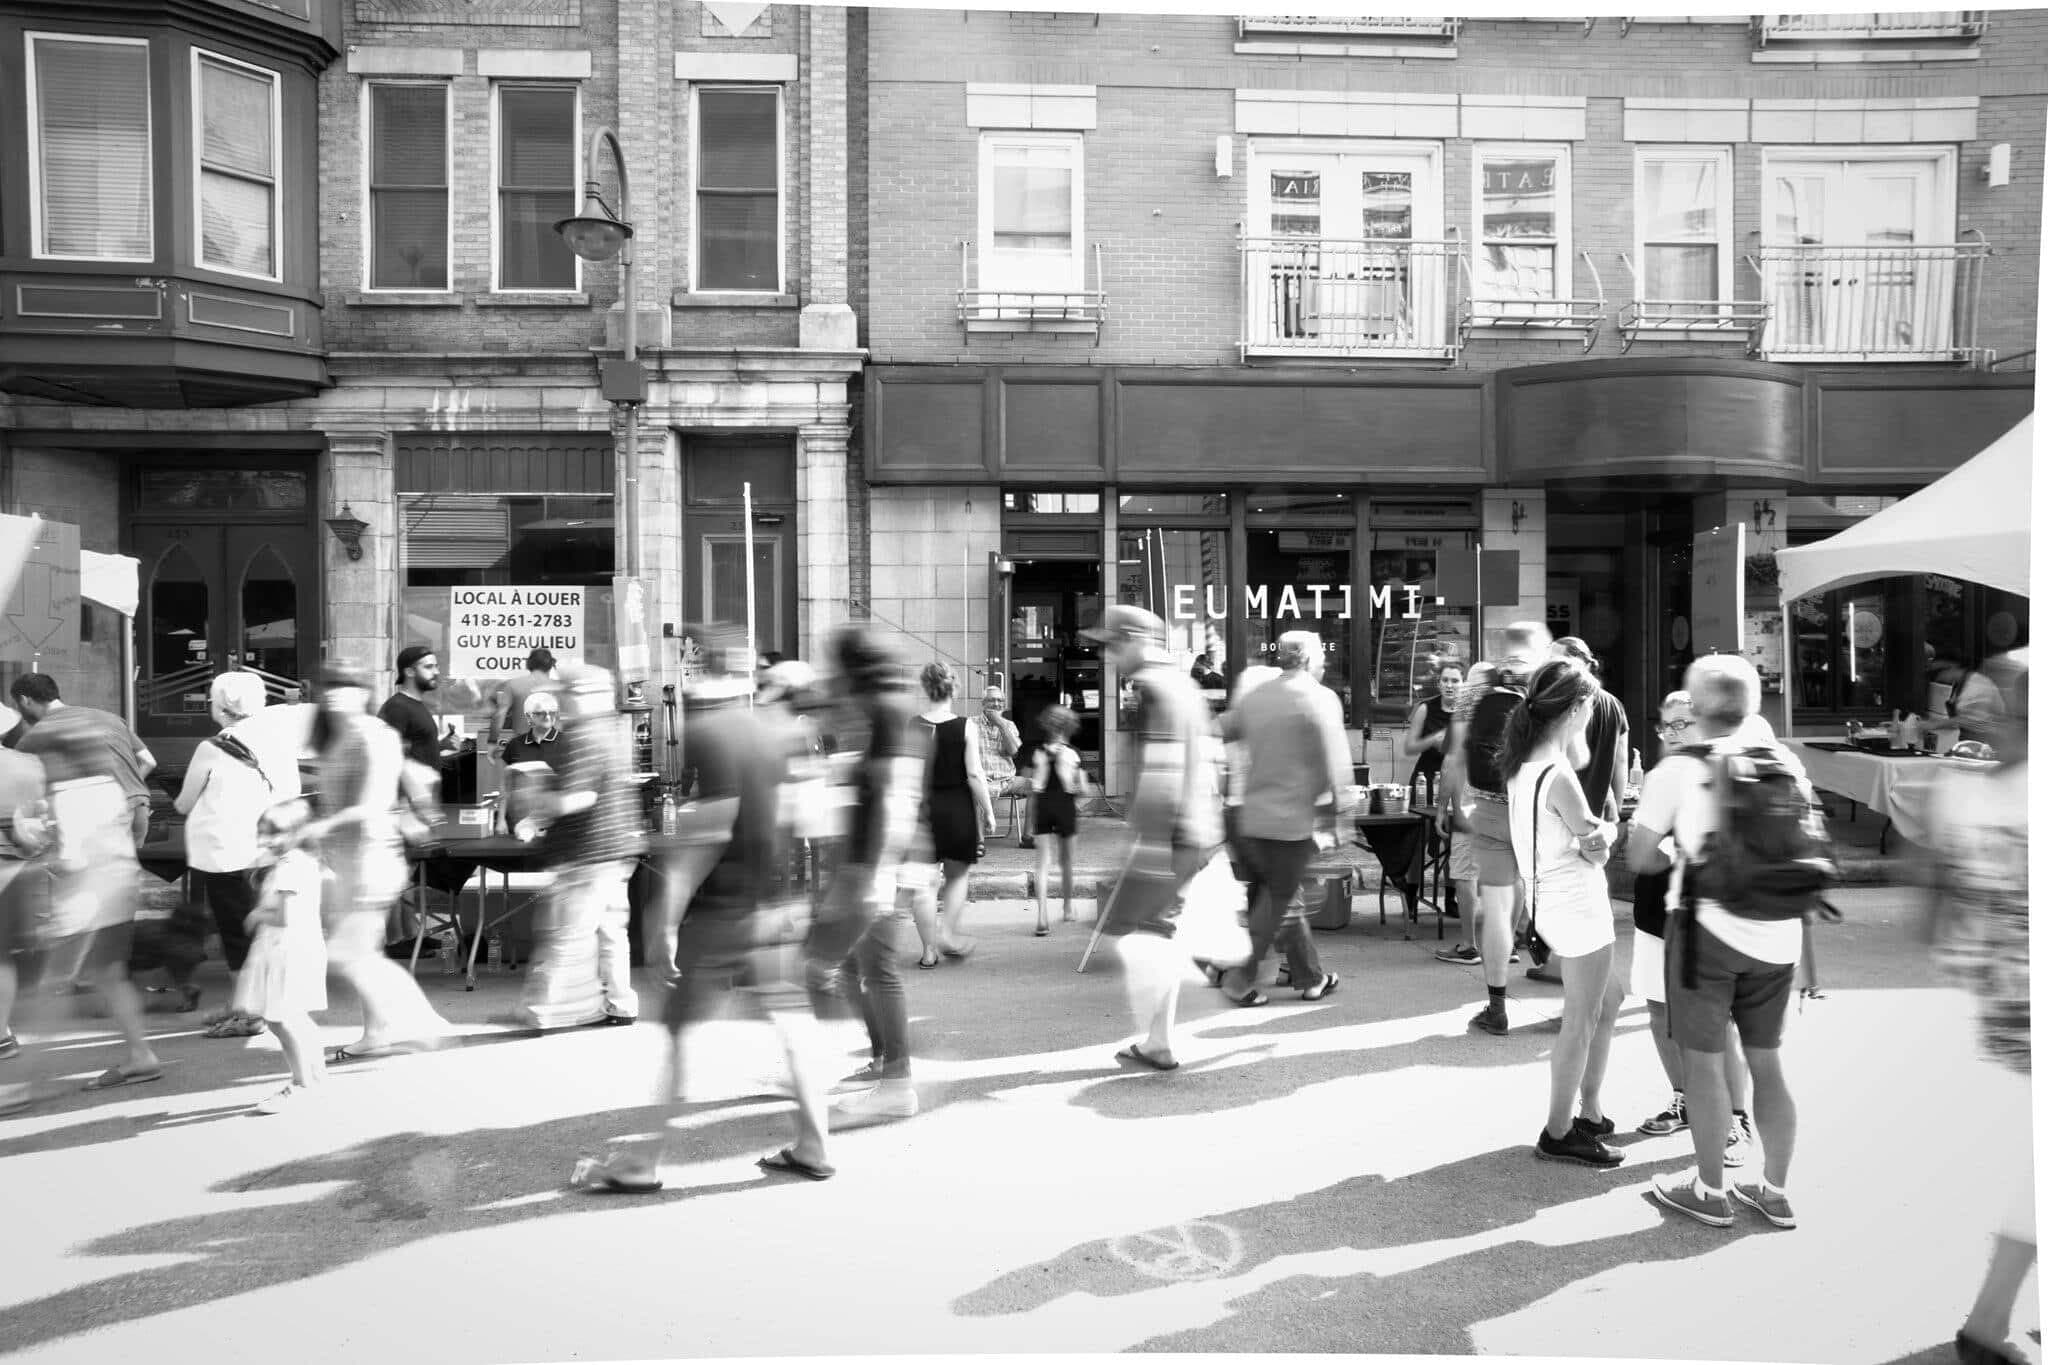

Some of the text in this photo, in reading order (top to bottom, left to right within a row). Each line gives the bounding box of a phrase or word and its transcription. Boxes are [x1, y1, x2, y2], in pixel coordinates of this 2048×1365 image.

[454, 589, 581, 606] LOCAL À LOUER
[461, 614, 572, 627] 418-261-2783
[457, 635, 576, 649] GUY BEAULIEU
